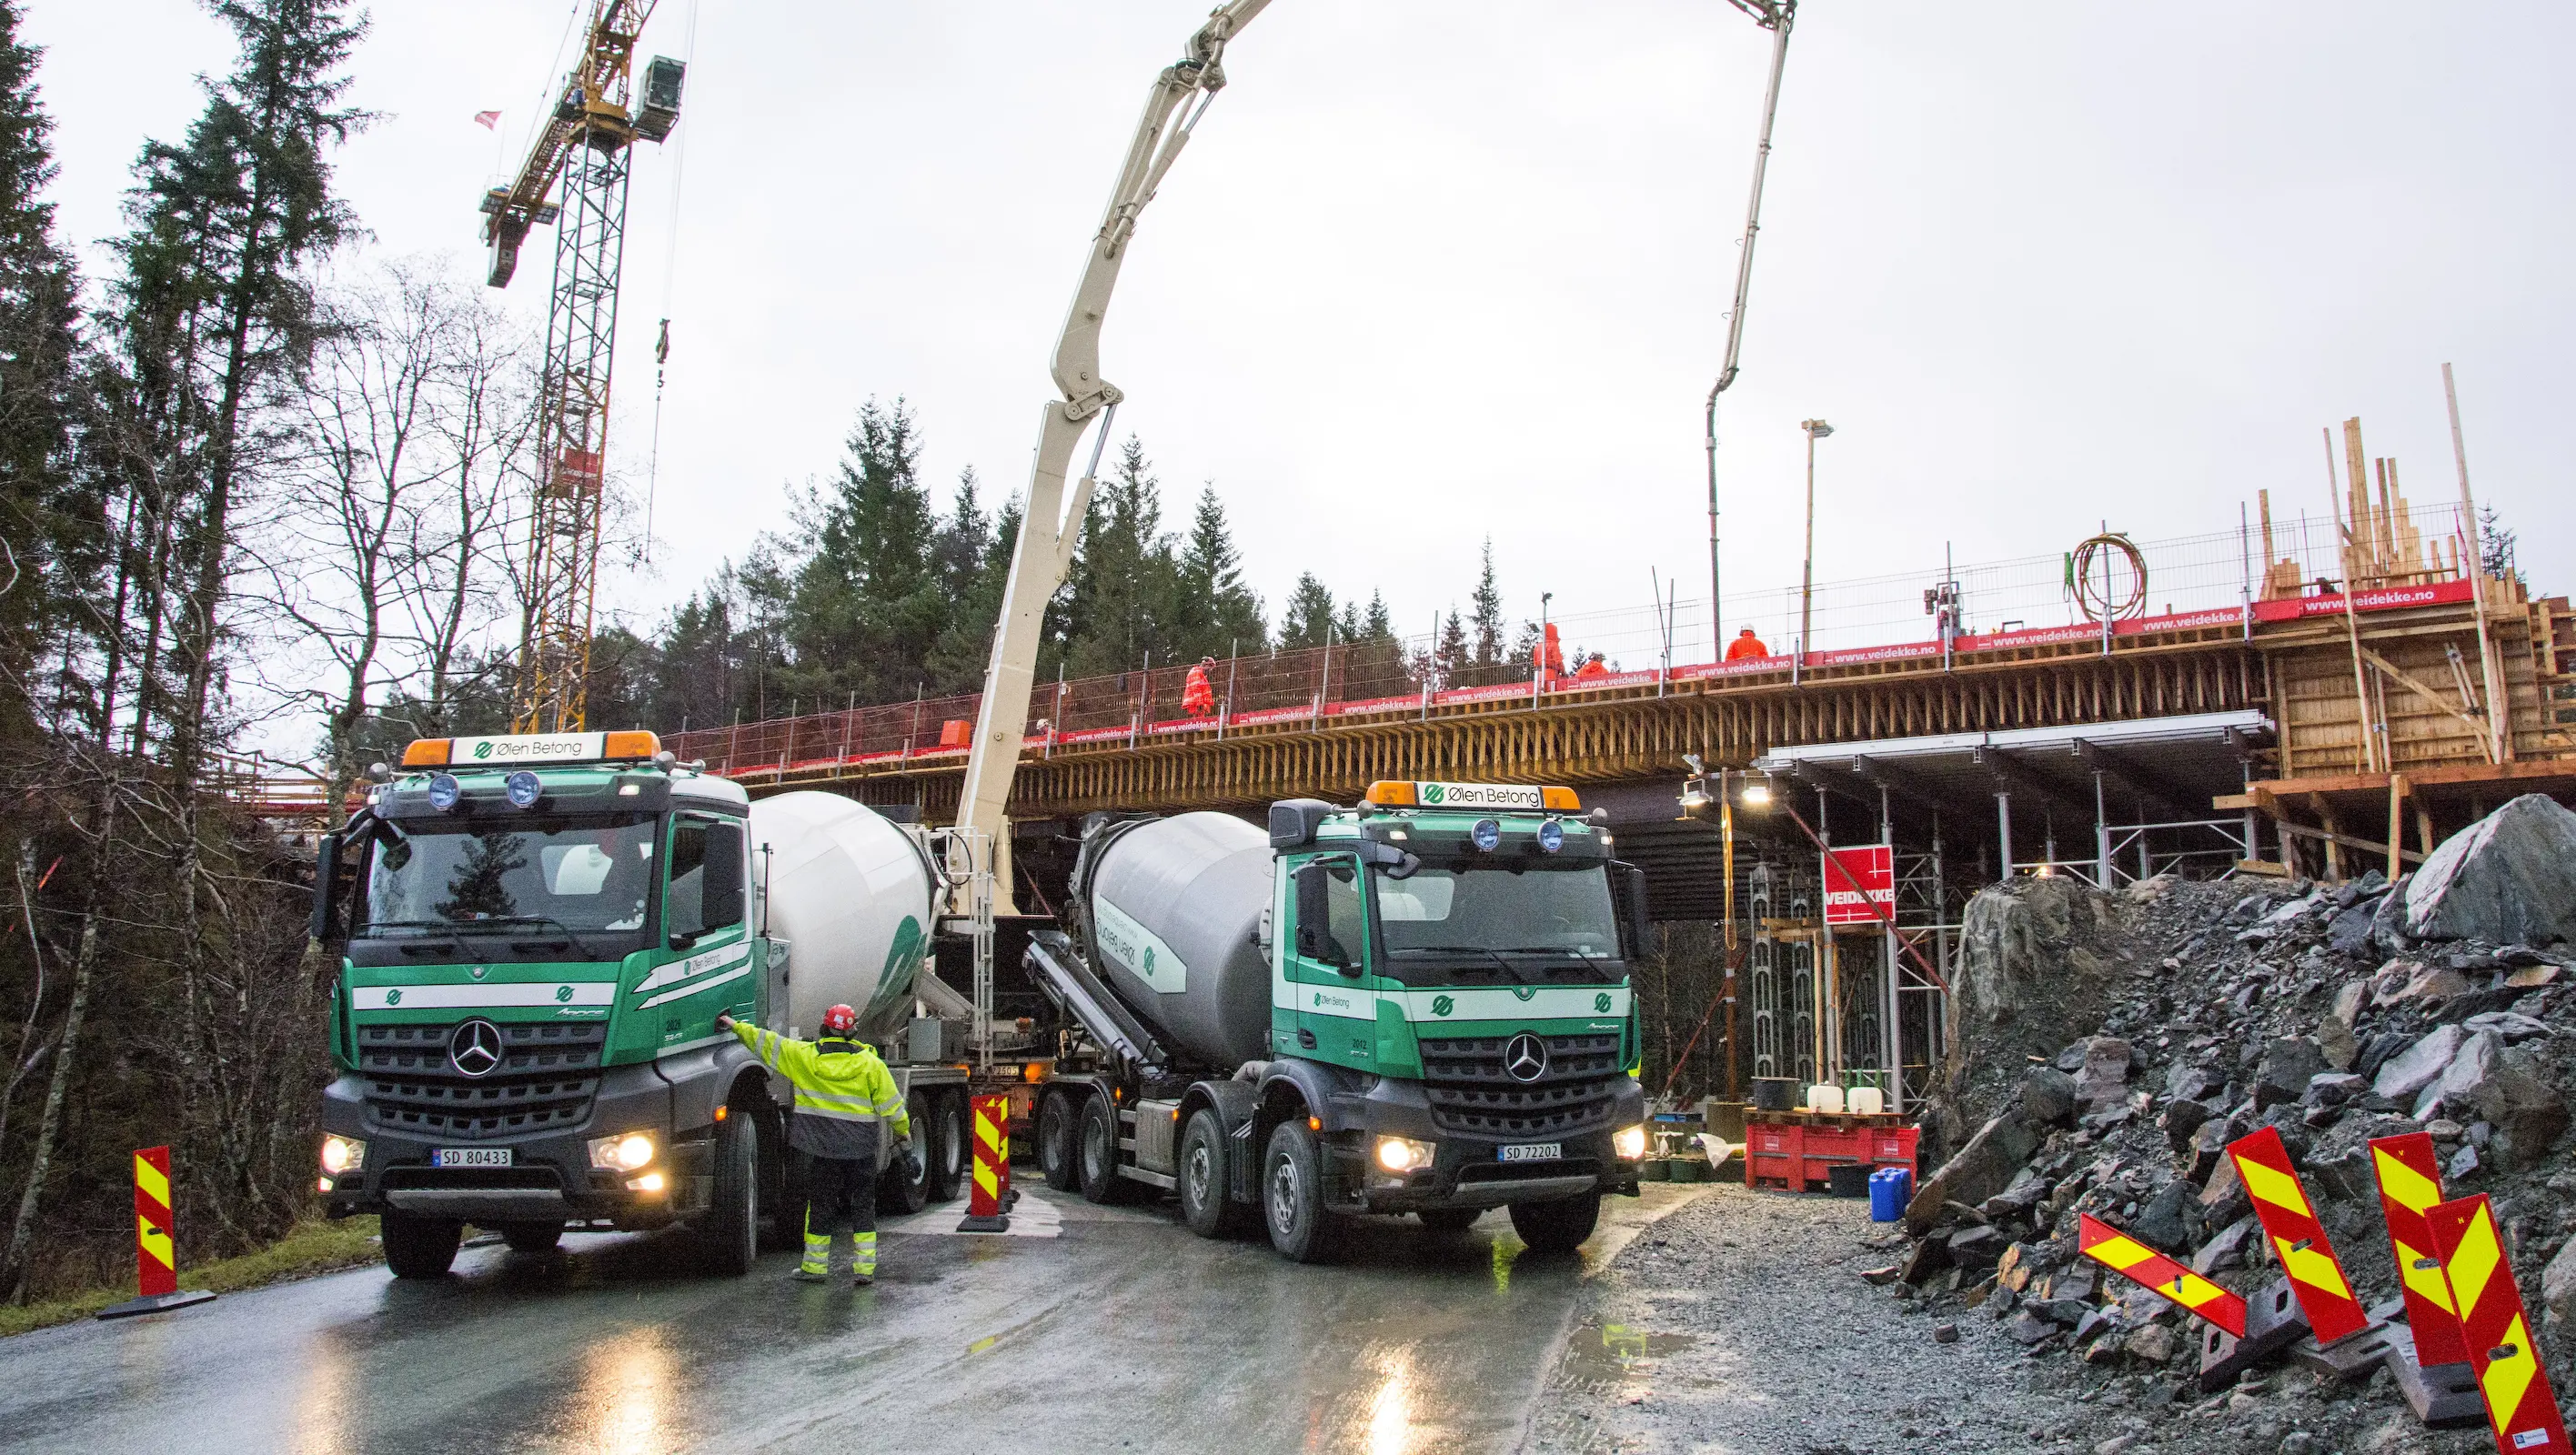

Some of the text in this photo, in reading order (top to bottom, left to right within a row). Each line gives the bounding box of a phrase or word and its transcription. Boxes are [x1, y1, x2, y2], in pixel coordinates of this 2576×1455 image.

[1993, 628, 2103, 646] www.veidekke.no
[1835, 646, 1936, 663] www.veidekke.no
[1697, 659, 1790, 677] www.veidekke.no
[1579, 674, 1653, 688] www.veidekke.
[1447, 687, 1526, 703] www.veidekke.no
[1344, 700, 1412, 714] www.veidekke.n
[1075, 729, 1132, 741] www.veidekke.no
[496, 741, 582, 756] Ølen Betong
[1448, 787, 1539, 808] Ølen Betong
[1096, 917, 1119, 953] Betong
[1333, 996, 1350, 1009] Betong
[444, 1150, 508, 1164] SD 80433
[1506, 1145, 1558, 1159] SD 72202
